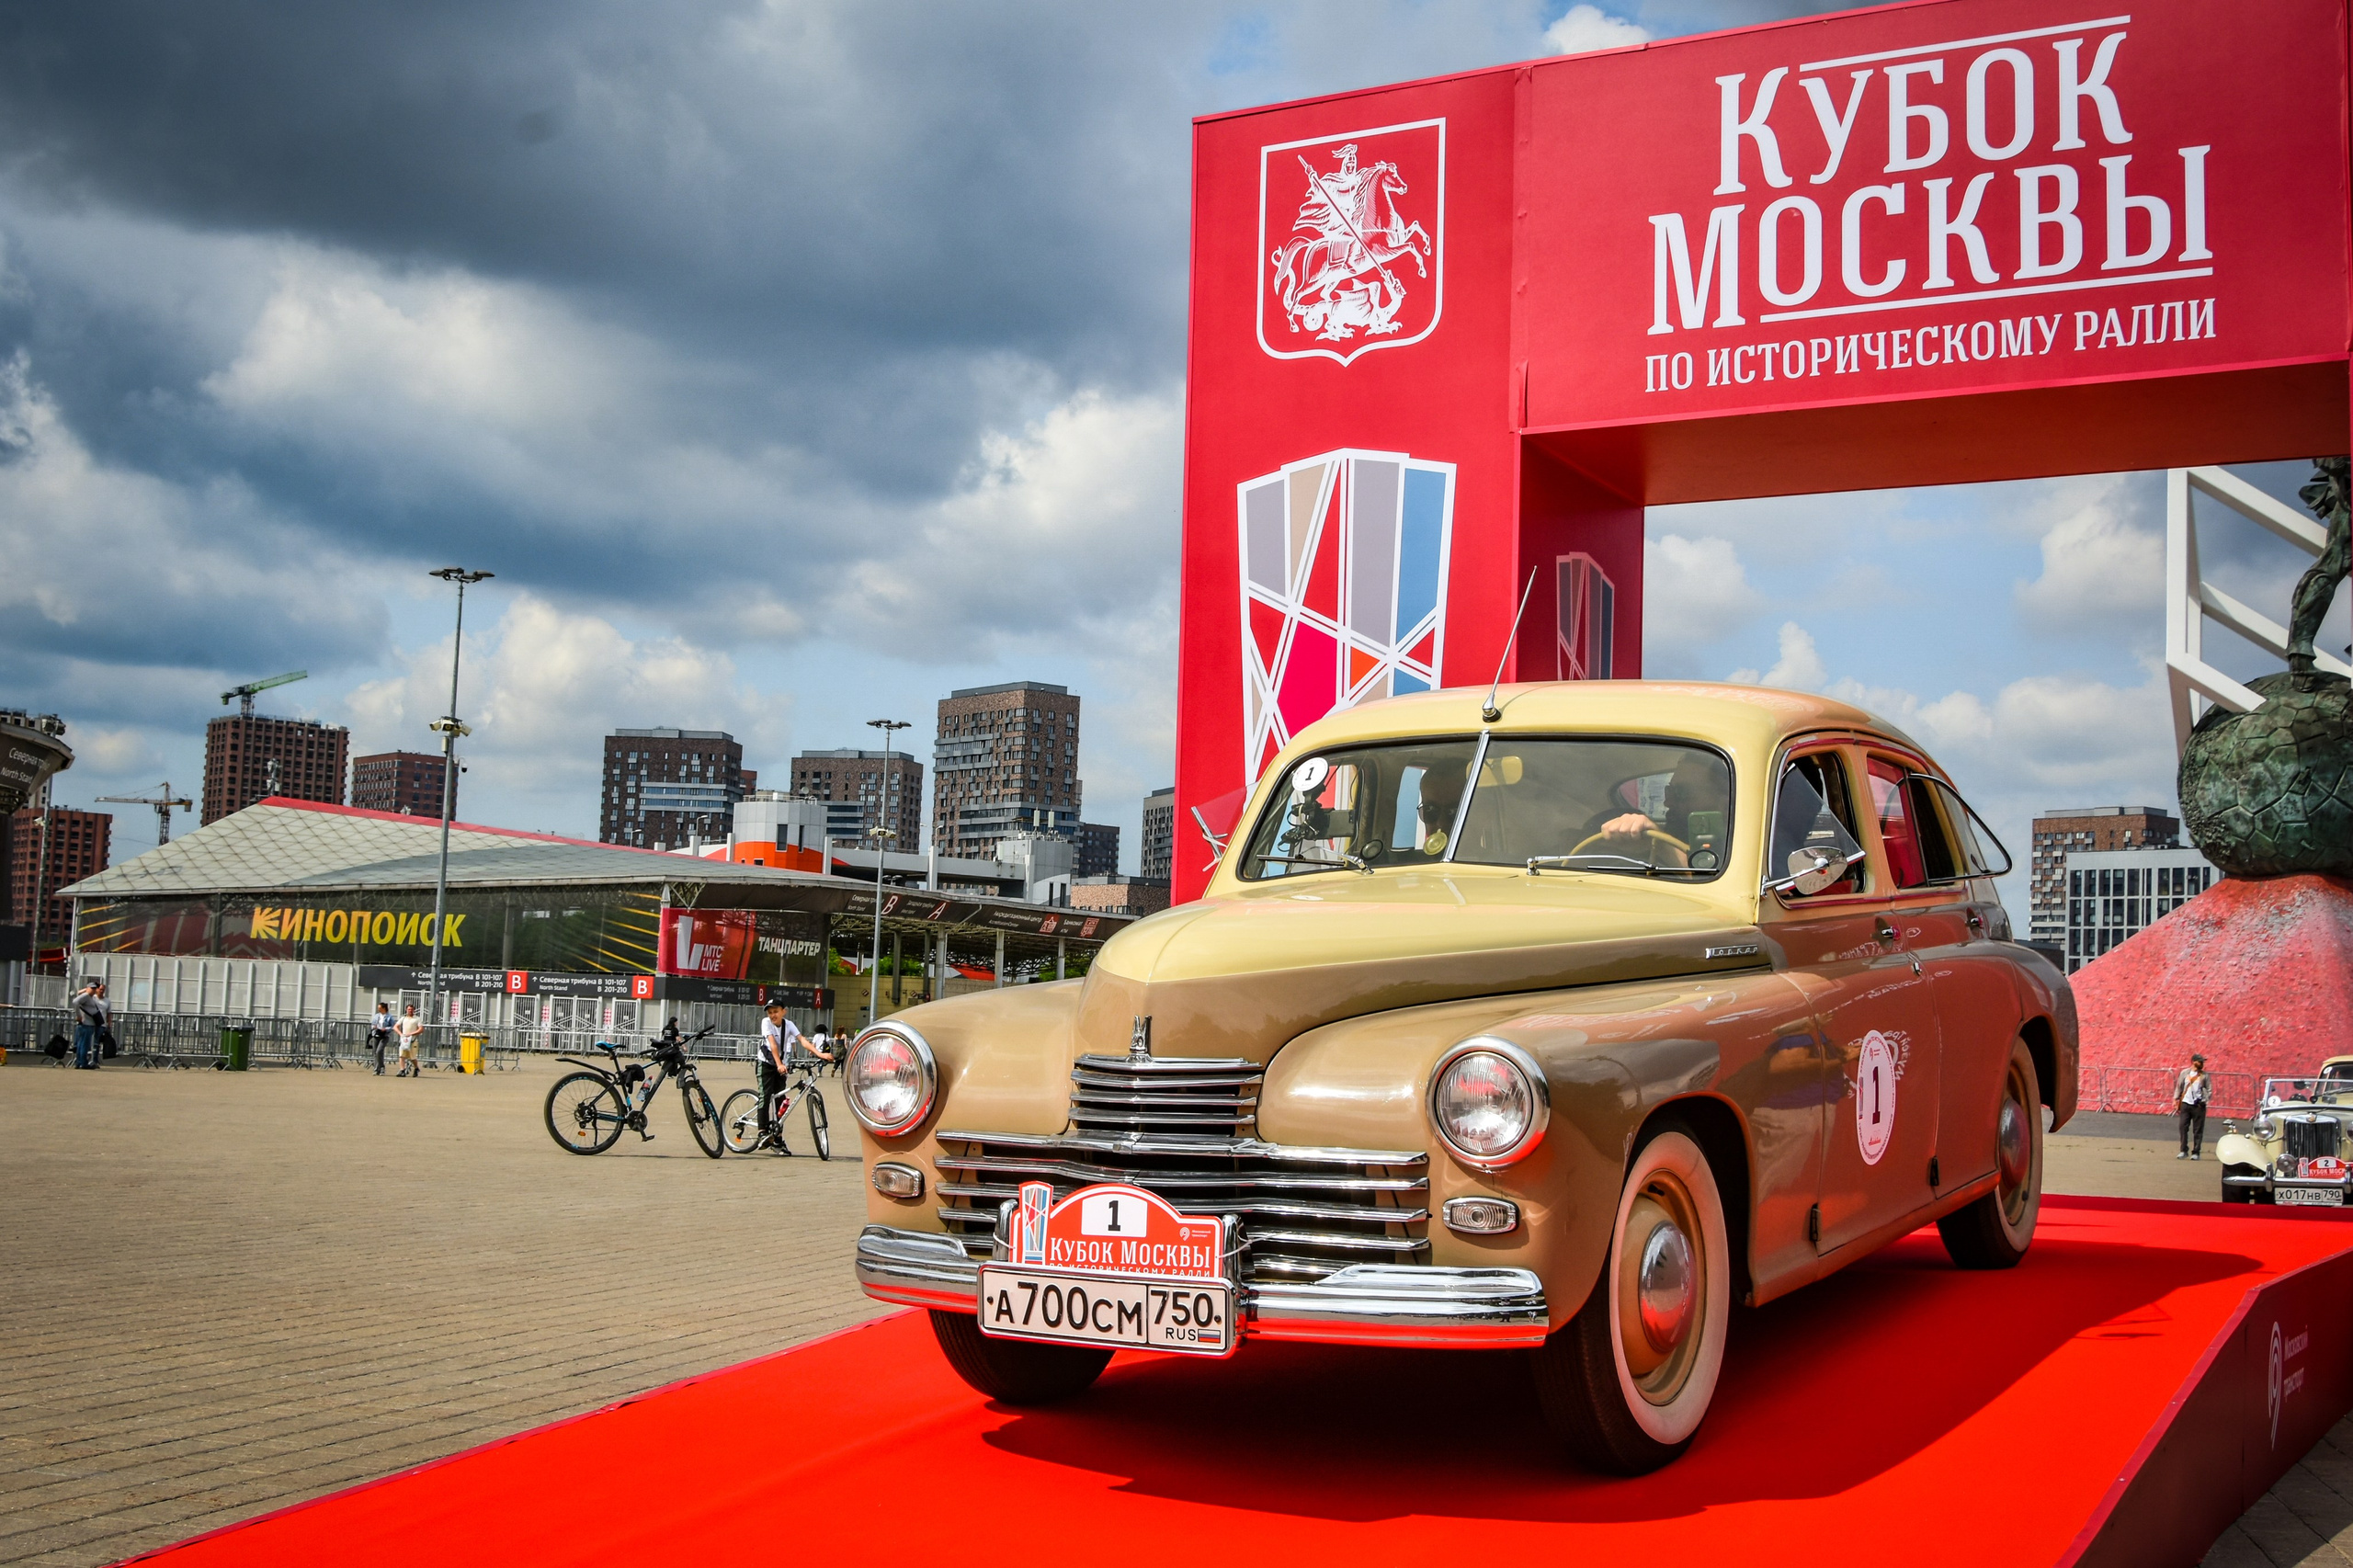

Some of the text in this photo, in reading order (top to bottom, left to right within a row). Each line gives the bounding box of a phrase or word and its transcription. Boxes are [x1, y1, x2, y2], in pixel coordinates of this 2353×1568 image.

[1713, 31, 2133, 196] КУБОК
[1647, 144, 2214, 335] МОСКВЫ
[1644, 298, 2216, 393] ПО ИСТОРИЧЕСКОМУ РАЛЛИ
[1305, 767, 1314, 781] 1
[250, 906, 466, 947] КИНОПОИСК
[758, 937, 821, 956] ТАНЦПАРТЕР
[417, 971, 473, 981] Севеая трибуна
[701, 958, 721, 971] LIVE
[539, 976, 597, 985] Северная трибуна
[1872, 1066, 1881, 1125] 1
[2324, 1159, 2329, 1167] 2
[2323, 1190, 2340, 1199] 790
[1108, 1200, 1121, 1232] 1
[1050, 1237, 1211, 1268] КУБОК МОСКВЫ
[1150, 1290, 1213, 1328] 750
[1165, 1327, 1197, 1341] RUS
